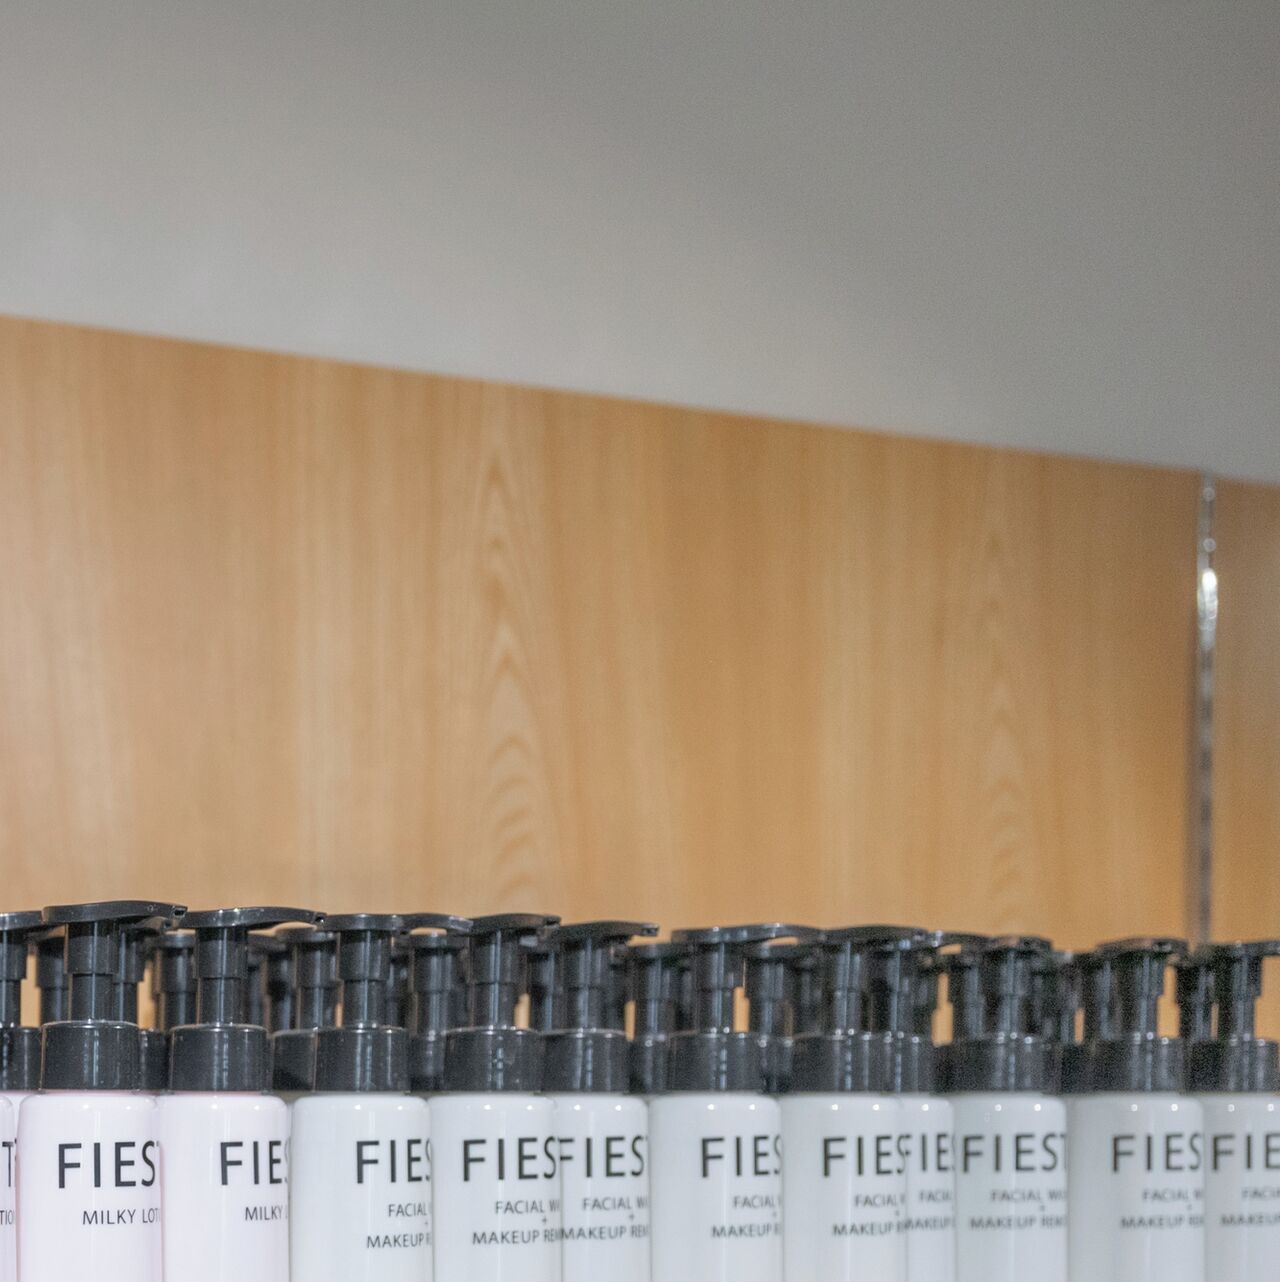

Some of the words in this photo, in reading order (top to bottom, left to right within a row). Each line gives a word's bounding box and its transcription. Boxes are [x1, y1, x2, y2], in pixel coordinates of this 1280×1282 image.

[462, 1136, 557, 1182] FIES
[388, 1202, 427, 1218] FACIAL
[495, 1200, 545, 1215] FACIAL
[583, 1197, 634, 1212] FACIAL
[82, 1209, 136, 1227] MILKY
[245, 1205, 283, 1221] MILKY
[472, 1230, 540, 1246] MAKEUP
[560, 1226, 628, 1241] MAKEUP
[712, 1223, 773, 1239] MAKEUP
[366, 1233, 425, 1248] MAKEUP
